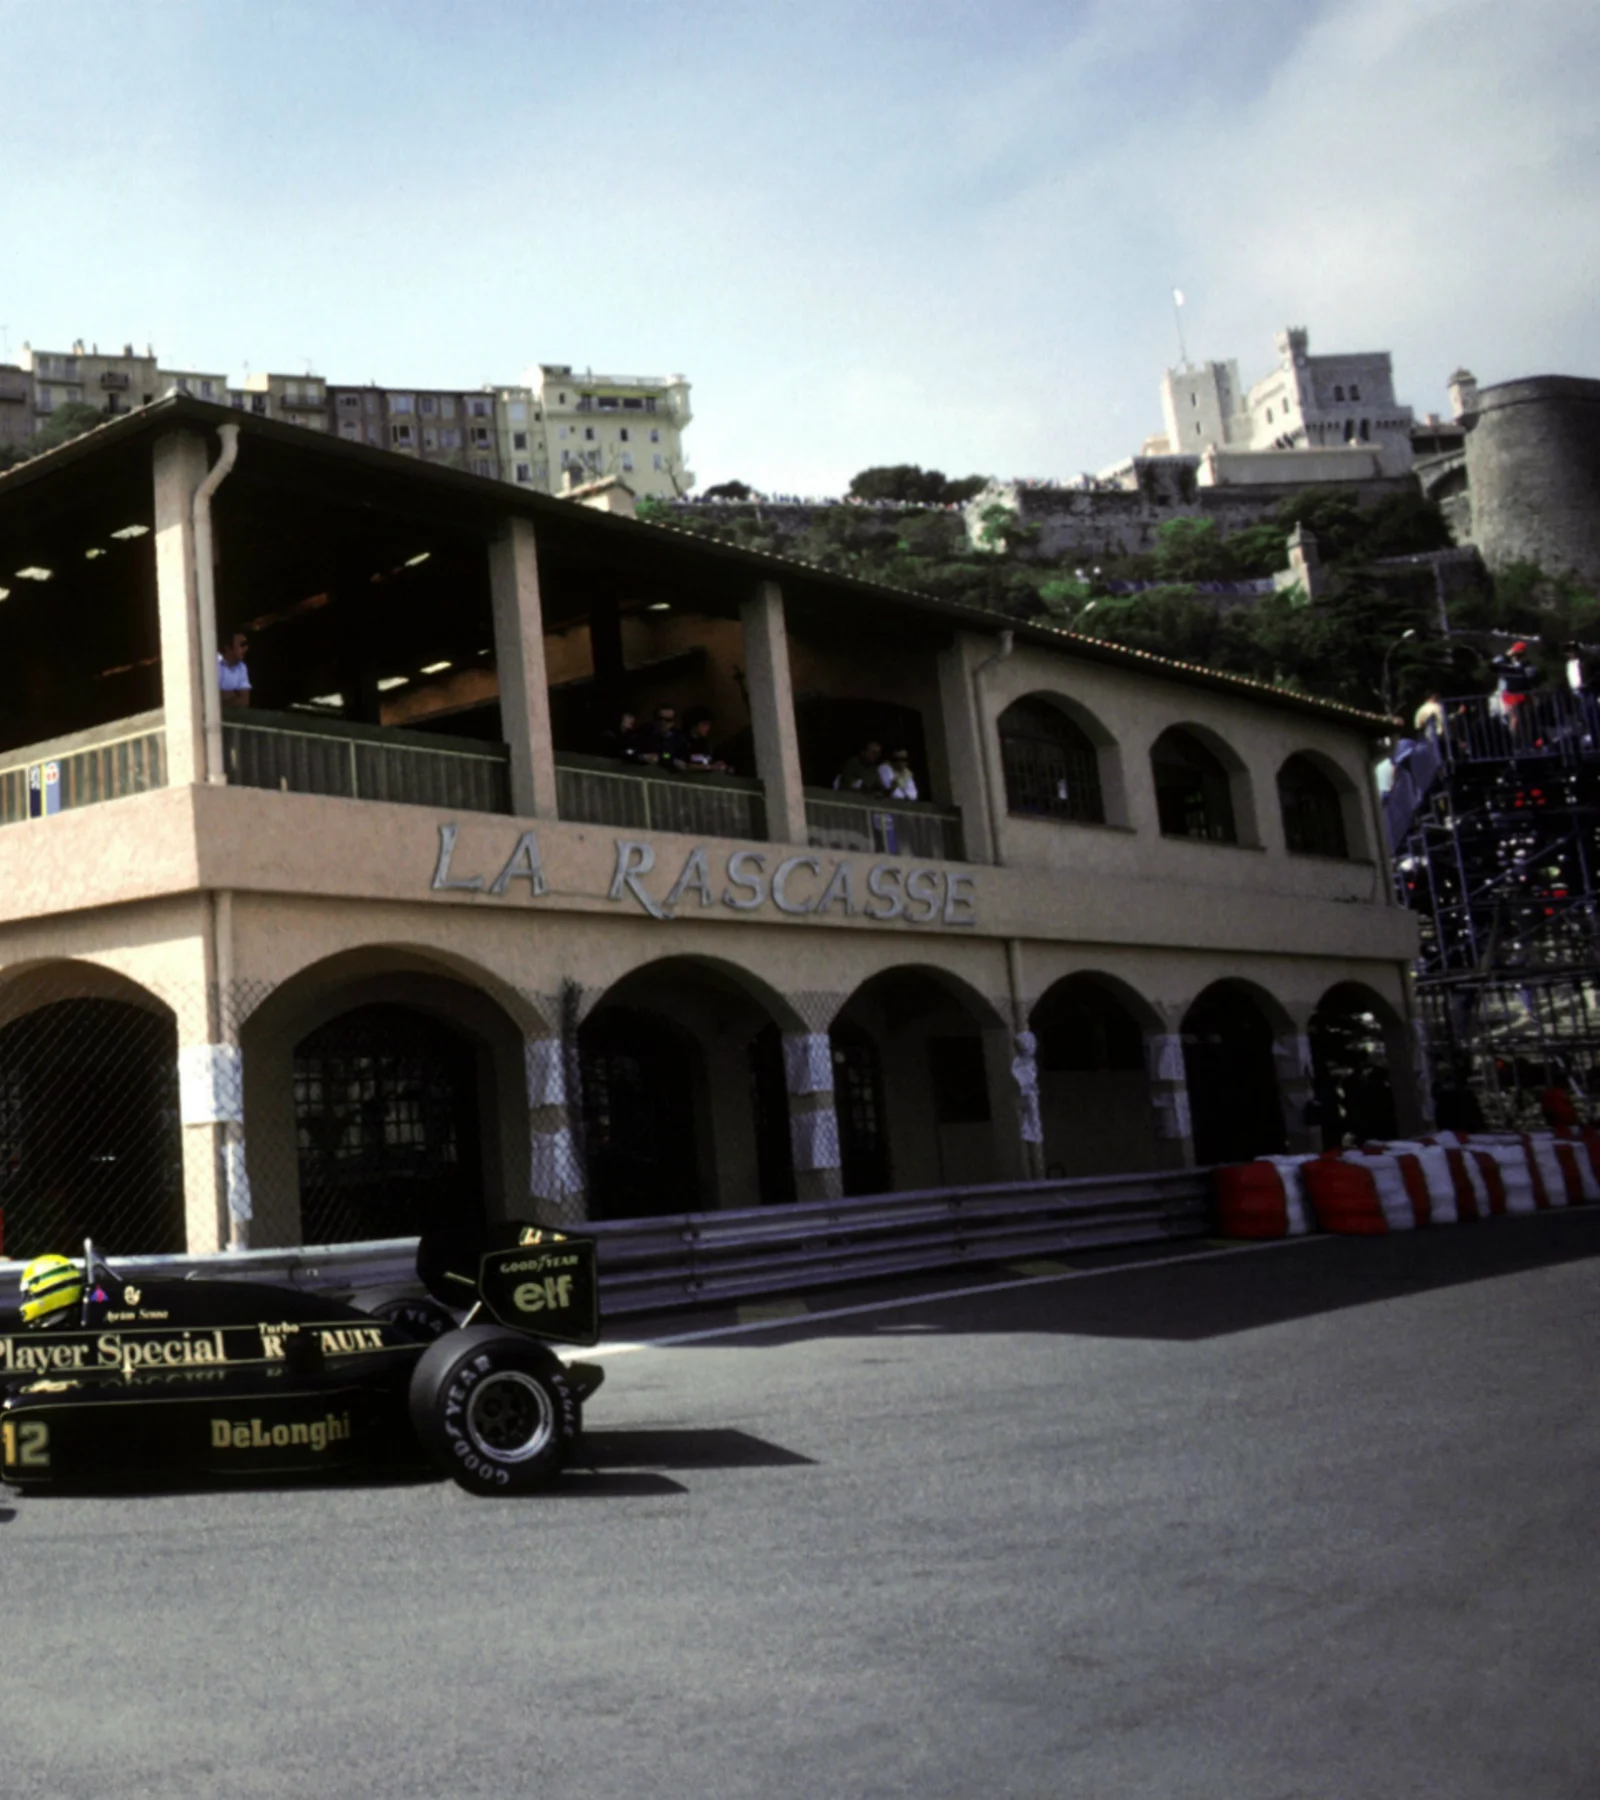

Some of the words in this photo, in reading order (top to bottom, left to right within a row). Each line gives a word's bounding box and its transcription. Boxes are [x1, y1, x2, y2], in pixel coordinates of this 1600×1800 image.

[430, 822, 548, 897] LA
[606, 838, 980, 927] RASCASSE
[500, 1254, 580, 1274] GOODYEAR
[513, 1274, 574, 1313] elf
[258, 1320, 300, 1335] Turbo
[97, 1329, 228, 1374] Special
[445, 1354, 511, 1486] GOODYEAR
[2, 1420, 50, 1466] 12
